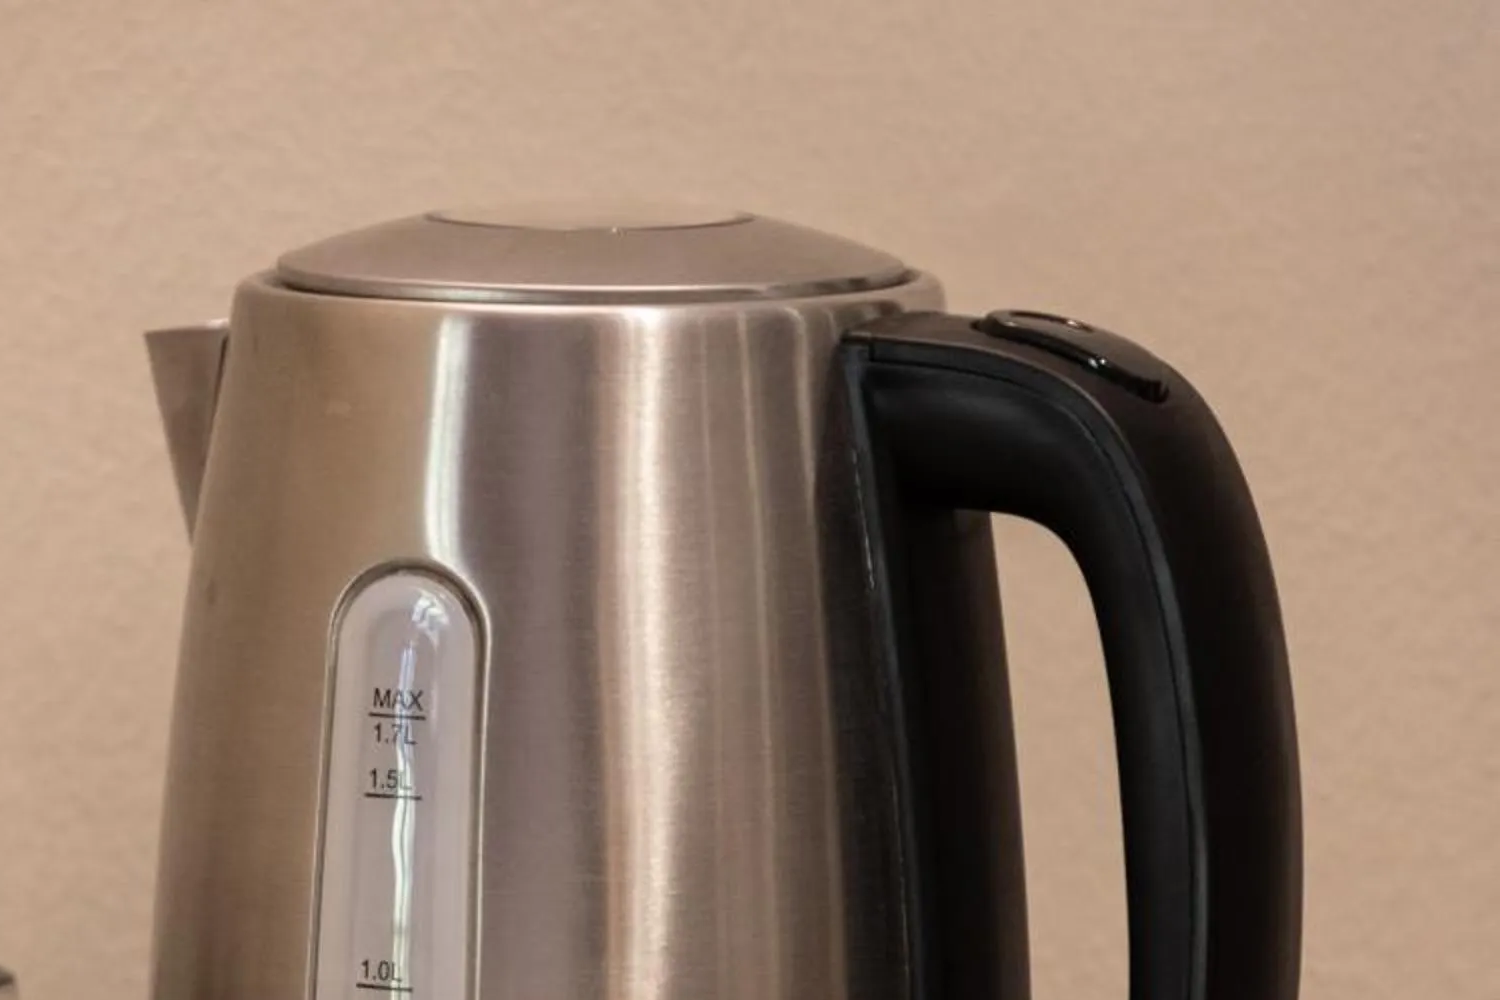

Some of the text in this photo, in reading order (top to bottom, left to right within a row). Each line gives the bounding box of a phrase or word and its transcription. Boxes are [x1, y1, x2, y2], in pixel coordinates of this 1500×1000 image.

[372, 687, 424, 712] MAX
[373, 722, 418, 745] 1.7L
[361, 959, 403, 983] 1.0L
